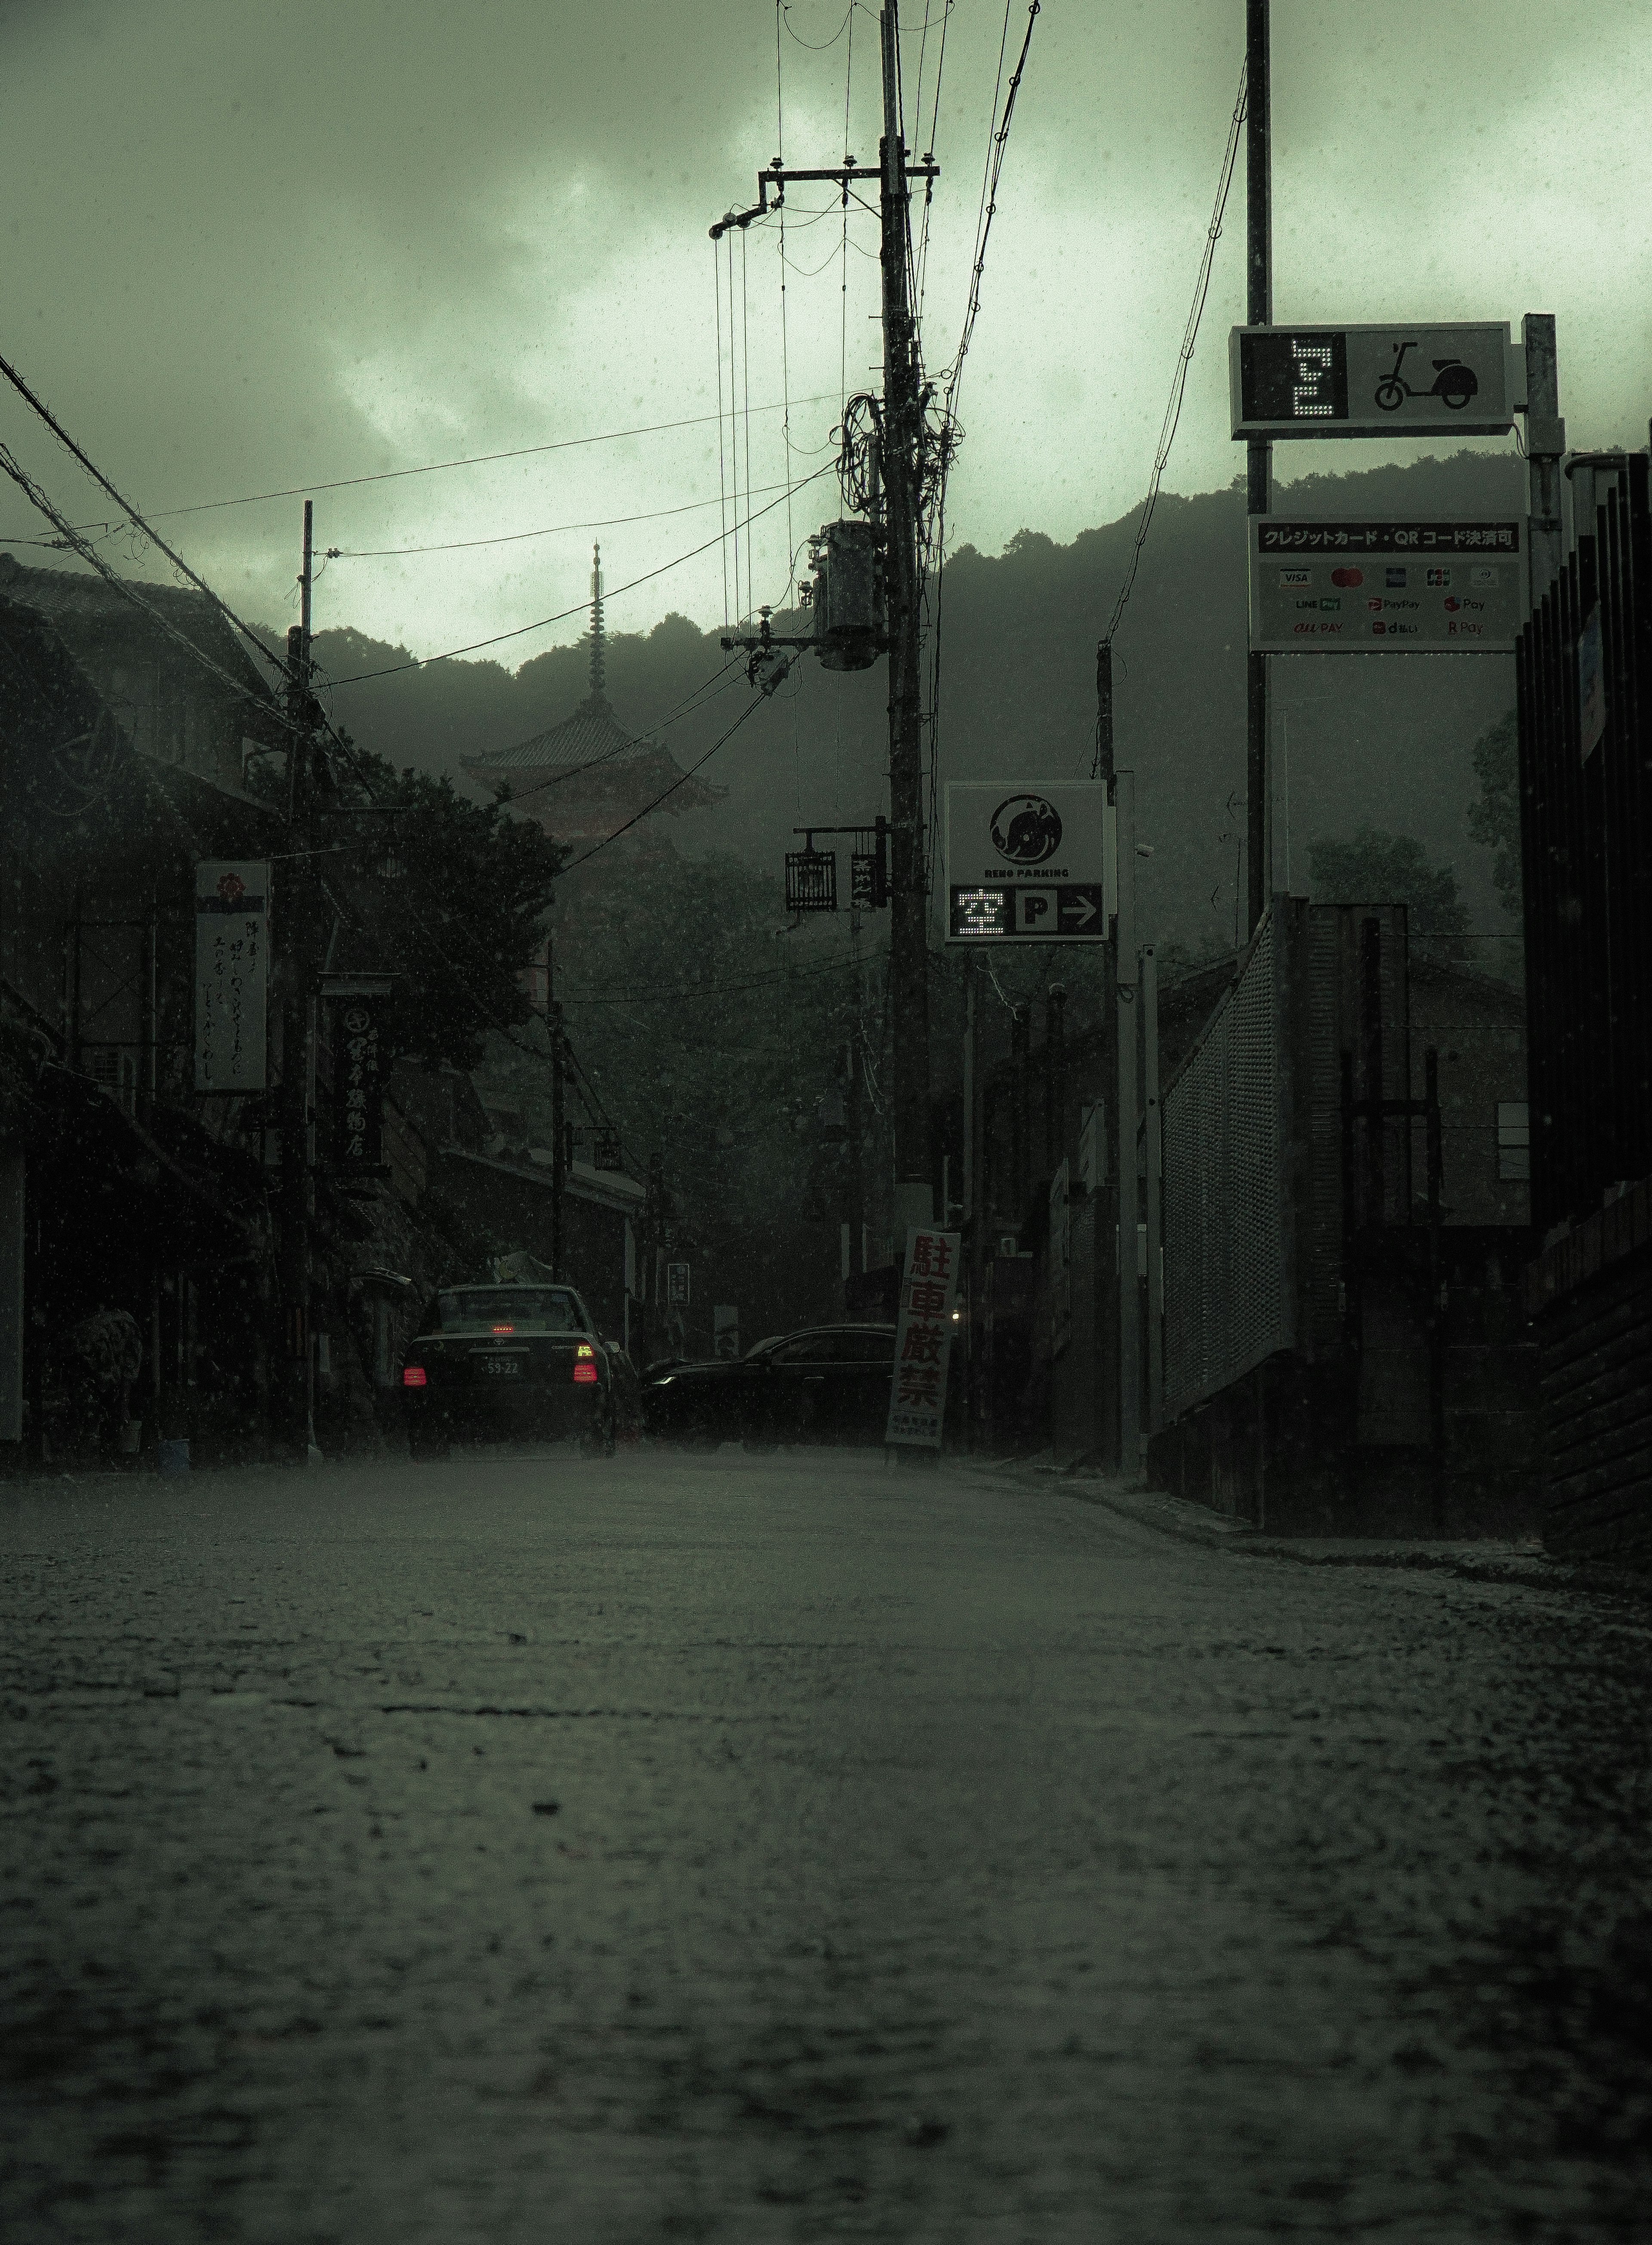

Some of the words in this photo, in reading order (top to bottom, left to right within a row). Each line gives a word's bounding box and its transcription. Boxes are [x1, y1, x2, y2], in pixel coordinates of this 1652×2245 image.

[1285, 573, 1308, 582] VISA
[1296, 600, 1317, 608] LINE
[1384, 600, 1420, 610] PayPay
[1464, 599, 1485, 611] Pay
[1321, 623, 1343, 633] PAY
[1388, 622, 1418, 634] d払い
[1461, 623, 1484, 635] Pay
[1017, 869, 1069, 877] PARKING
[958, 888, 1004, 934] 空
[1025, 896, 1049, 925] P
[897, 1235, 952, 1407] 駐車厳禁
